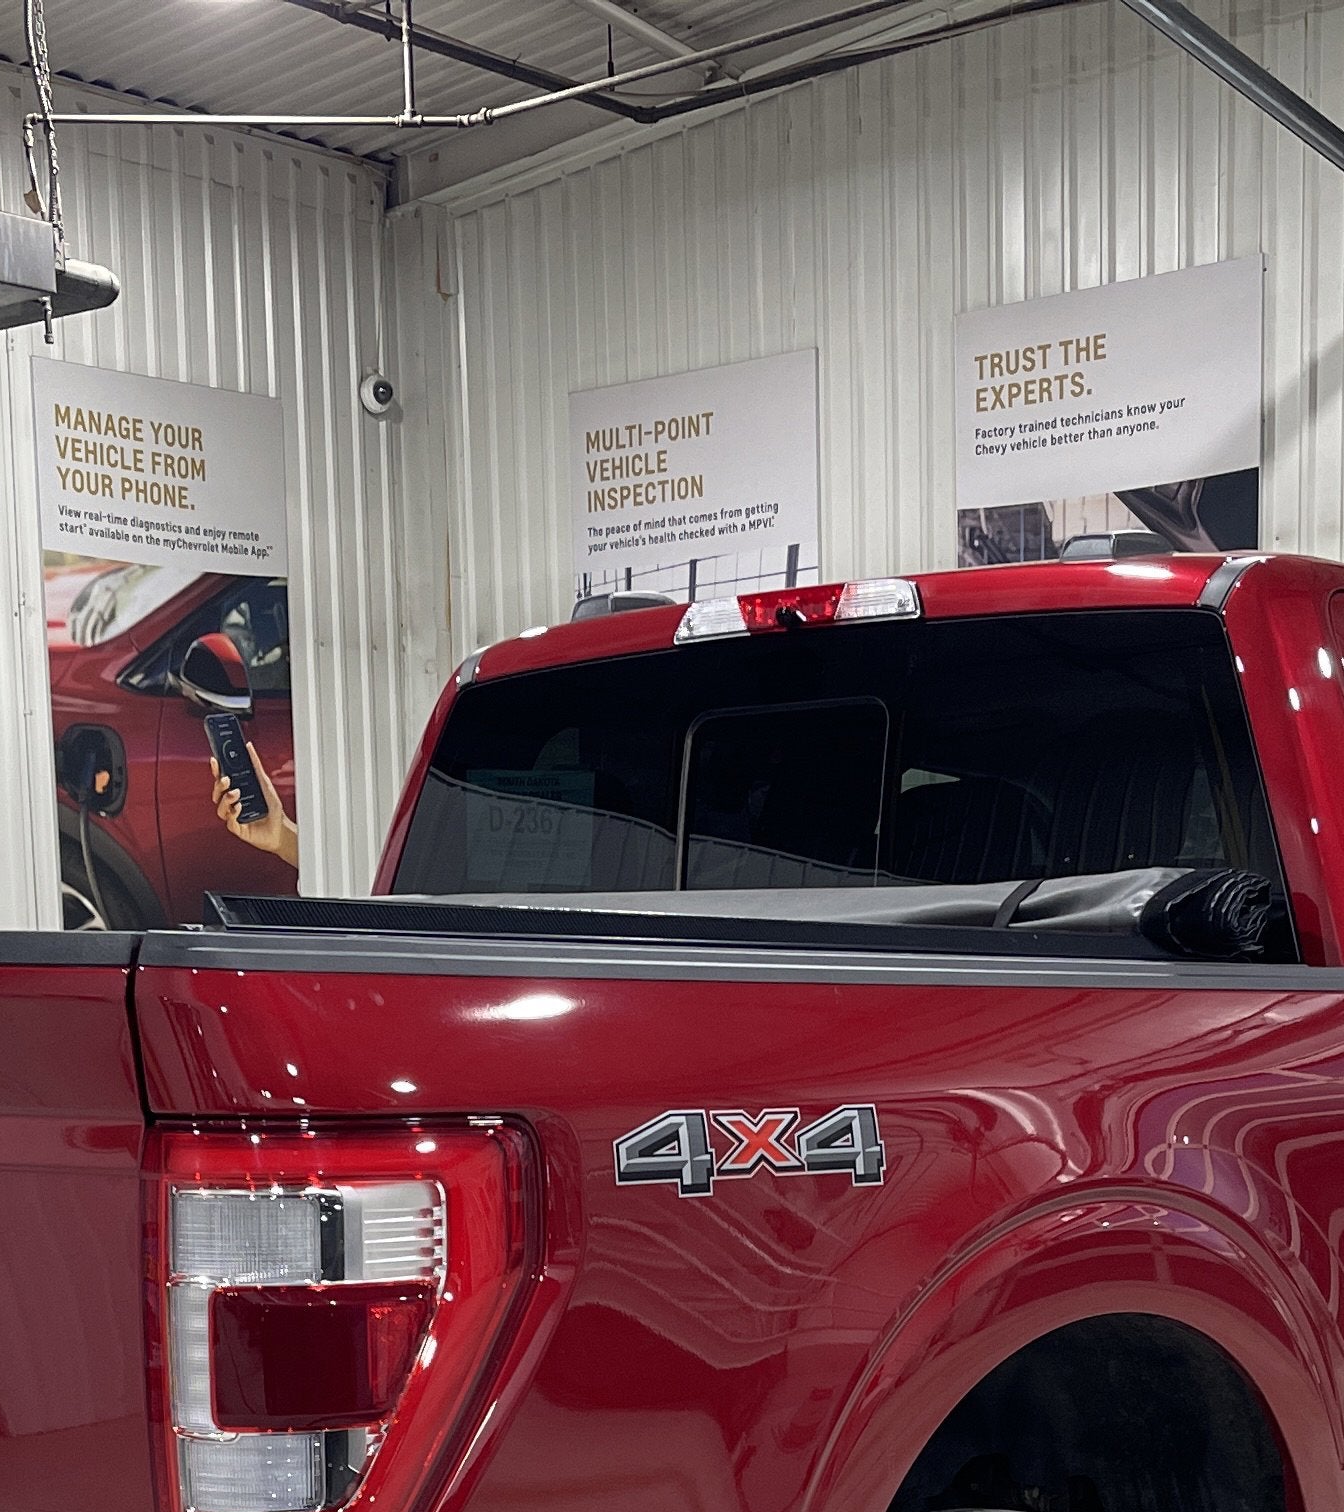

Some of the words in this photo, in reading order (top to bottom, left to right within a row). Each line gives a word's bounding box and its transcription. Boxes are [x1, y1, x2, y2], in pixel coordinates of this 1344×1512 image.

[975, 344, 1051, 380] TRUST
[1059, 334, 1106, 366] THE
[975, 372, 1092, 413] EXPERTS.
[54, 403, 144, 442] MANAGE
[150, 421, 203, 451] YOUR
[585, 412, 714, 454] MULTI-POINT
[975, 426, 1015, 440] Factory
[1018, 417, 1057, 434] trained
[1060, 408, 1123, 427] technicians
[1126, 402, 1156, 417] know
[1159, 397, 1185, 414] your
[975, 442, 1007, 456] Chevy
[1010, 436, 1047, 452] vehicle
[1050, 431, 1084, 446] better
[1088, 427, 1112, 440] than
[1116, 420, 1159, 436] anyone.
[55, 435, 144, 473] VEHICLE
[151, 451, 207, 482] FROM
[586, 450, 668, 483] VEHICLE
[56, 465, 114, 499] YOUR
[120, 477, 196, 510] PHONE.
[587, 474, 704, 513] INSPECTION
[57, 505, 81, 518] View
[83, 510, 128, 526] real-time
[130, 516, 182, 534] diagnostics
[185, 525, 200, 536] and
[203, 528, 226, 541] enjoy
[228, 531, 259, 541] remote
[587, 527, 603, 538] The
[606, 525, 630, 538] peace
[633, 520, 642, 531] of
[644, 517, 665, 530] mind
[668, 514, 687, 527] that
[689, 513, 717, 525] comes
[720, 508, 742, 520] from
[745, 502, 778, 518] getting
[587, 543, 607, 556] your
[648, 530, 677, 545] health
[678, 525, 715, 541] checked
[718, 522, 738, 536] with
[740, 523, 746, 532] a
[88, 526, 129, 542] available
[132, 534, 143, 543] on
[146, 535, 160, 546] the
[163, 538, 219, 554] myChevrolet
[221, 544, 248, 556] Mobile
